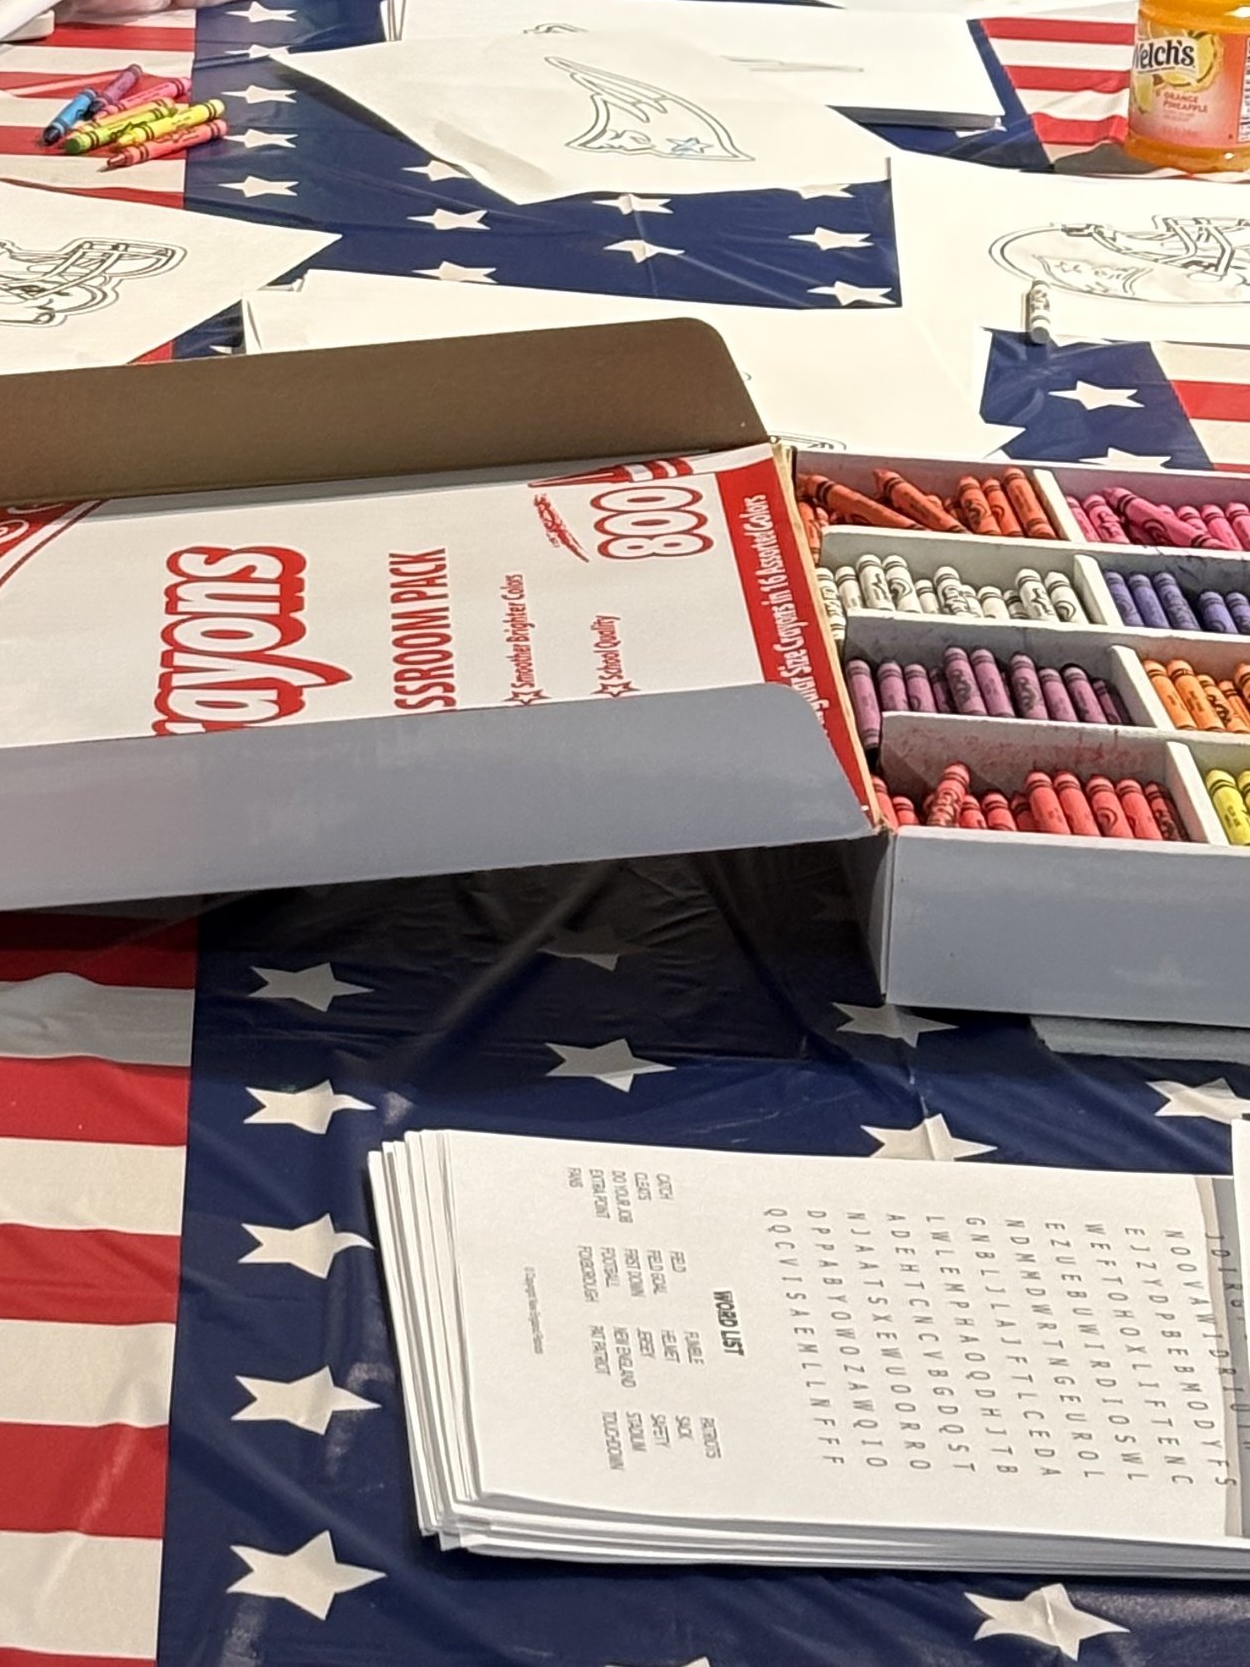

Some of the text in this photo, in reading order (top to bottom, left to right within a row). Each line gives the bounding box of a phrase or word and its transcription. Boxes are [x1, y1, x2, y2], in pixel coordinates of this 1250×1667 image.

[1162, 100, 1208, 113] PINEAPPLE
[1164, 91, 1199, 103] ORANGE
[590, 485, 714, 560] 800
[739, 494, 774, 535] Colors
[747, 531, 786, 577] Assorted
[757, 575, 789, 593] 16
[760, 592, 793, 607] in
[152, 545, 354, 736] ayons
[388, 547, 458, 711] SSROOM PACK
[500, 574, 536, 689] Smoother Brighter Colors
[590, 615, 624, 681] School Quality
[767, 604, 809, 651] Crayons
[778, 649, 812, 678] Size
[714, 1290, 745, 1357] WORD LIST
